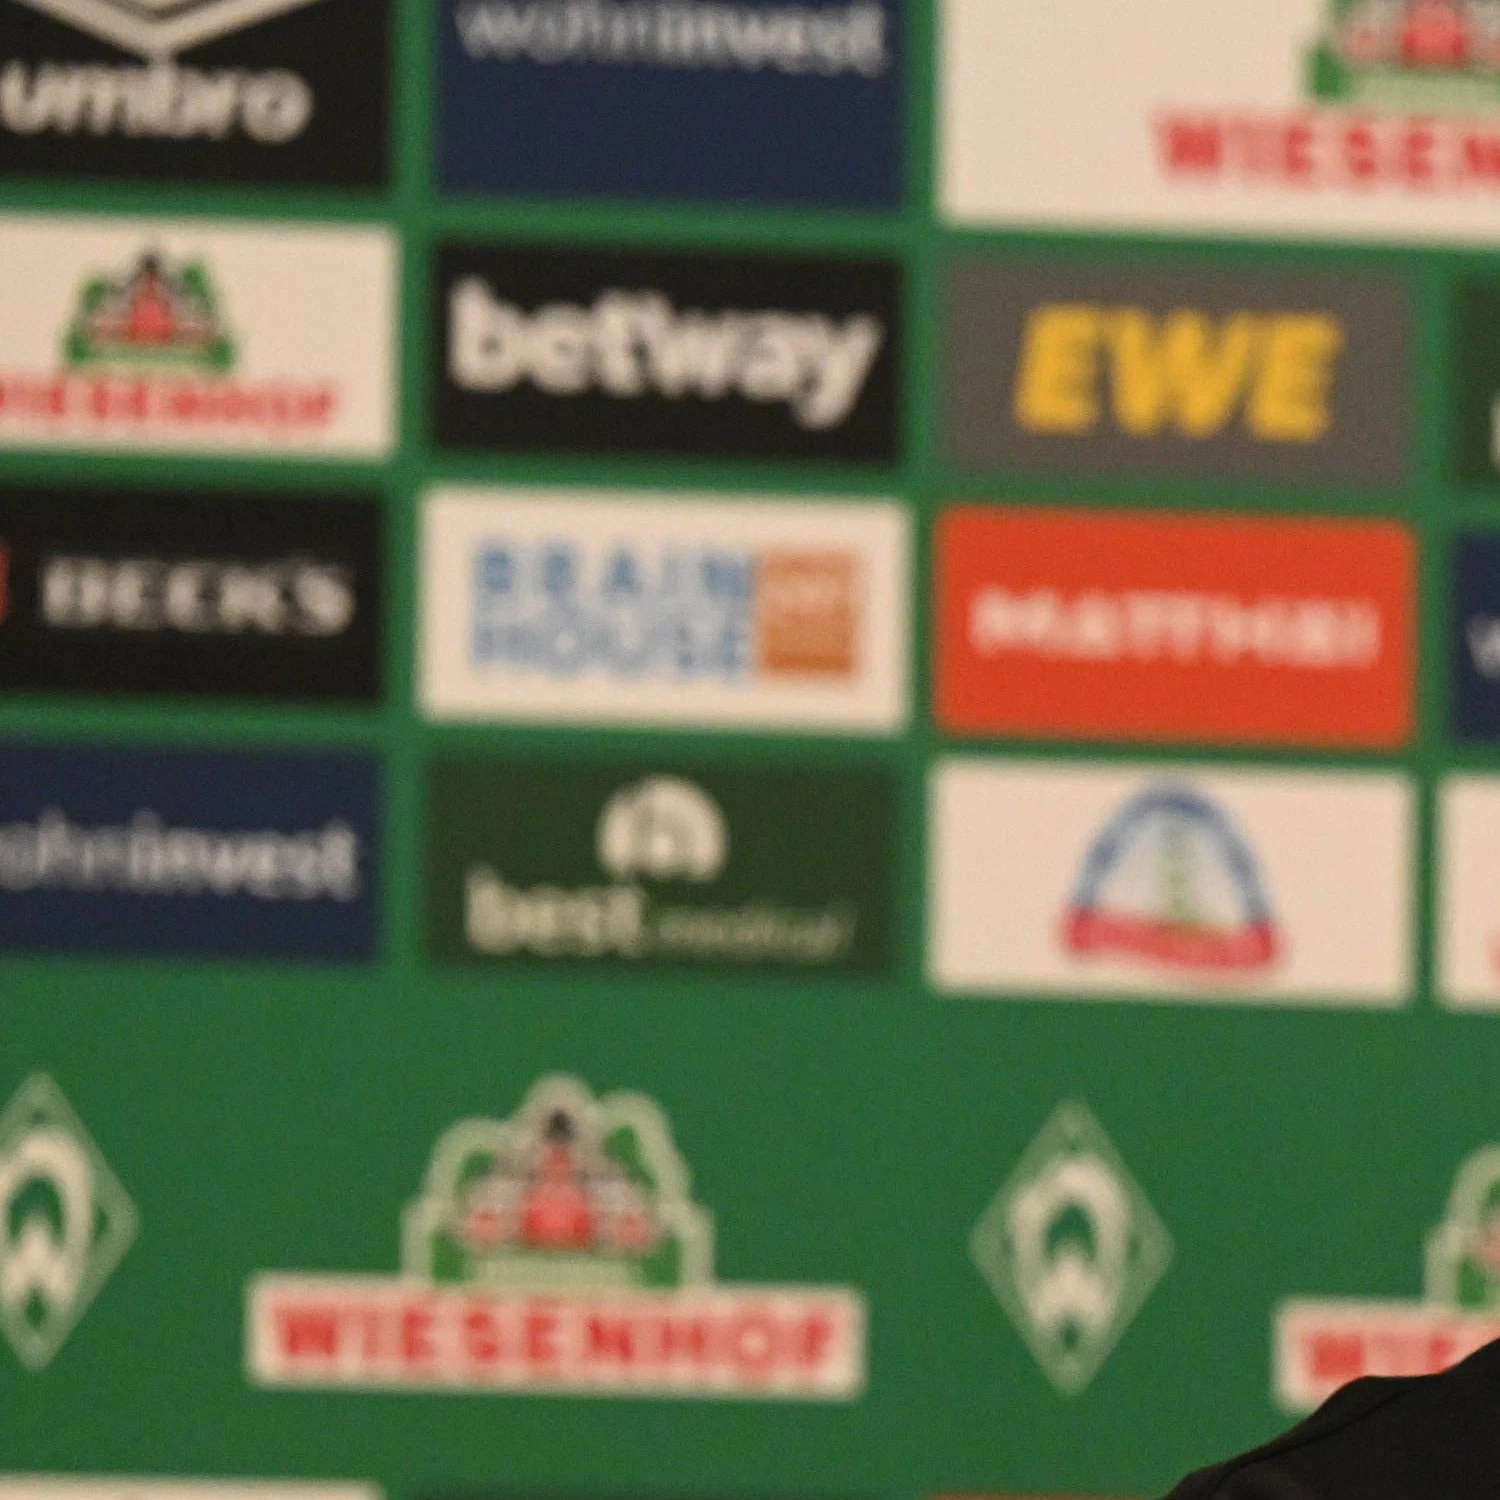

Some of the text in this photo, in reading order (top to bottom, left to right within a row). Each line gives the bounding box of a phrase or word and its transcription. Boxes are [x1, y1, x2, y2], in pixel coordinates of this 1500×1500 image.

[0, 62, 312, 142] umbro
[449, 280, 880, 428] betway
[1015, 304, 1342, 441] EWE
[0, 376, 335, 430] IESENHOF
[275, 1304, 835, 1384] WIESENHOF
